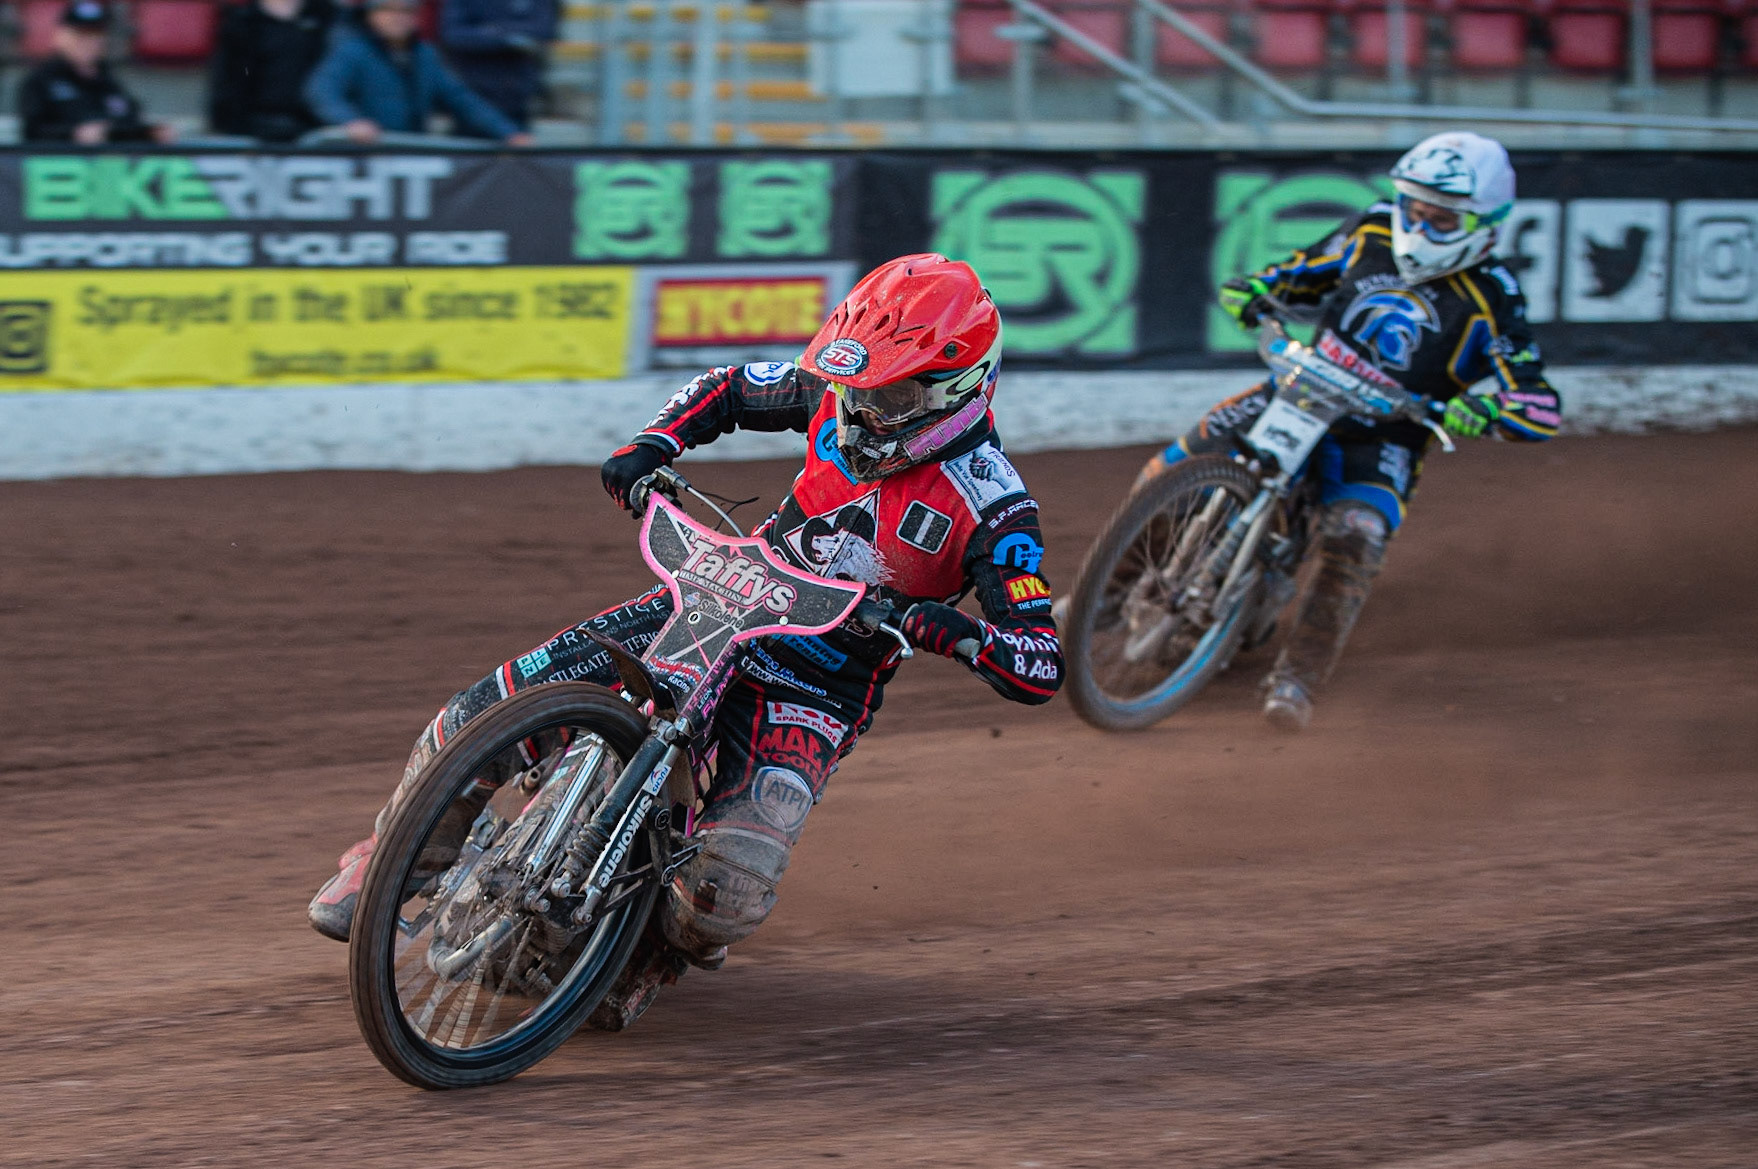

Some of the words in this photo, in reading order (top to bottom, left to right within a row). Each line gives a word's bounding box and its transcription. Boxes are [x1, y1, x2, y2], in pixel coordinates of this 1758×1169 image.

[21, 156, 452, 220] BIKERIGHT
[0, 231, 251, 267] UPPORTING
[261, 231, 397, 266] YOUR
[404, 230, 507, 265] RIDE
[77, 285, 232, 334] Sprayed
[249, 284, 276, 321] in
[292, 286, 349, 322] the
[360, 285, 408, 321] UK
[424, 285, 519, 321] since
[822, 347, 860, 367] STS
[988, 450, 1016, 478] FRIENDS
[681, 539, 796, 613] Taffys
[699, 600, 744, 630] Silkolene
[1017, 601, 1032, 611] THE
[538, 650, 612, 685] ASTLEGATE
[1014, 654, 1027, 676] &
[1028, 658, 1058, 680] Ada
[667, 675, 691, 694] Racing
[697, 687, 713, 710] LEON
[776, 715, 809, 724] SPARK
[812, 719, 838, 744] PLUGS
[653, 766, 669, 793] FUCHS
[599, 794, 653, 888] Silkolene
